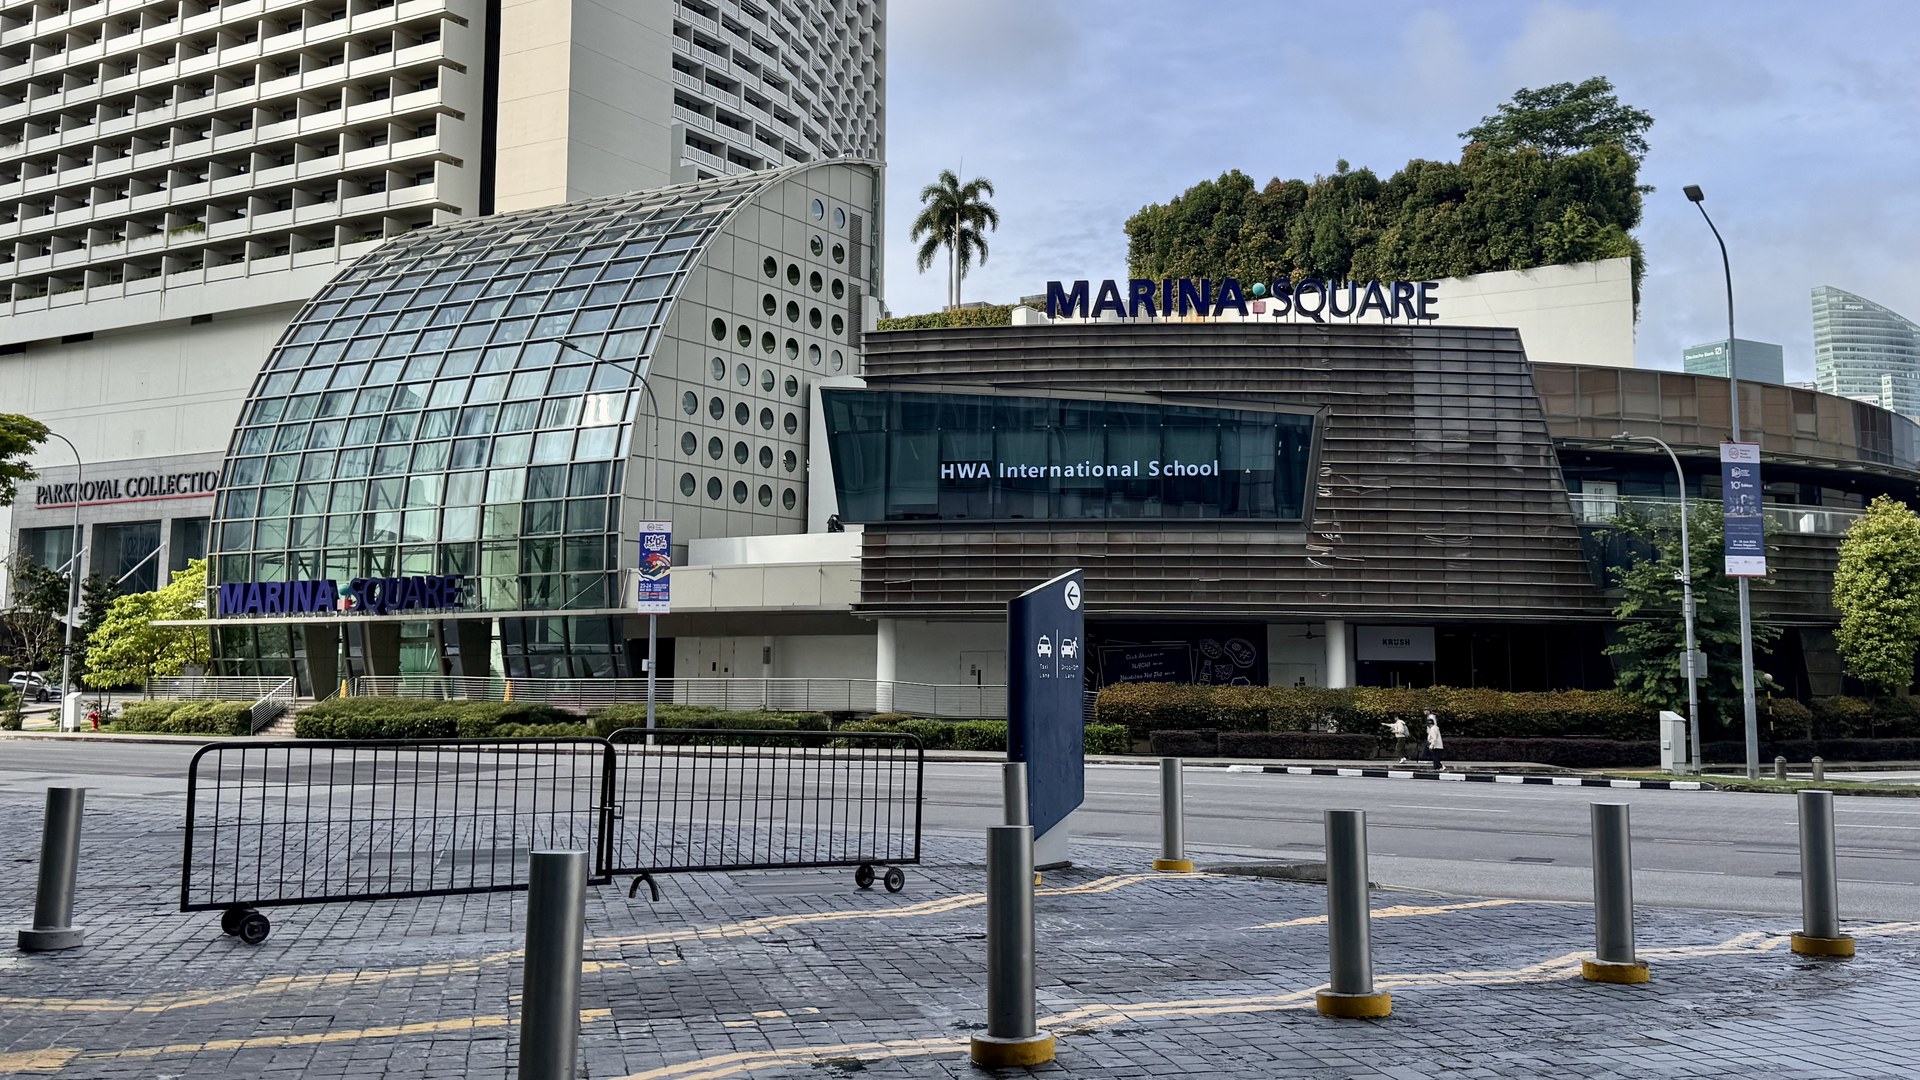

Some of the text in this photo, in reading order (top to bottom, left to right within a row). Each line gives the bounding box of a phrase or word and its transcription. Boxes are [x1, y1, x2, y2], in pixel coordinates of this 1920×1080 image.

[1046, 278, 1440, 323] MARINA SQUARE
[36, 471, 220, 506] PARKROYAL COLLECTIO
[940, 460, 1219, 479] HWA International School
[220, 574, 464, 615] MARINA SQUARE
